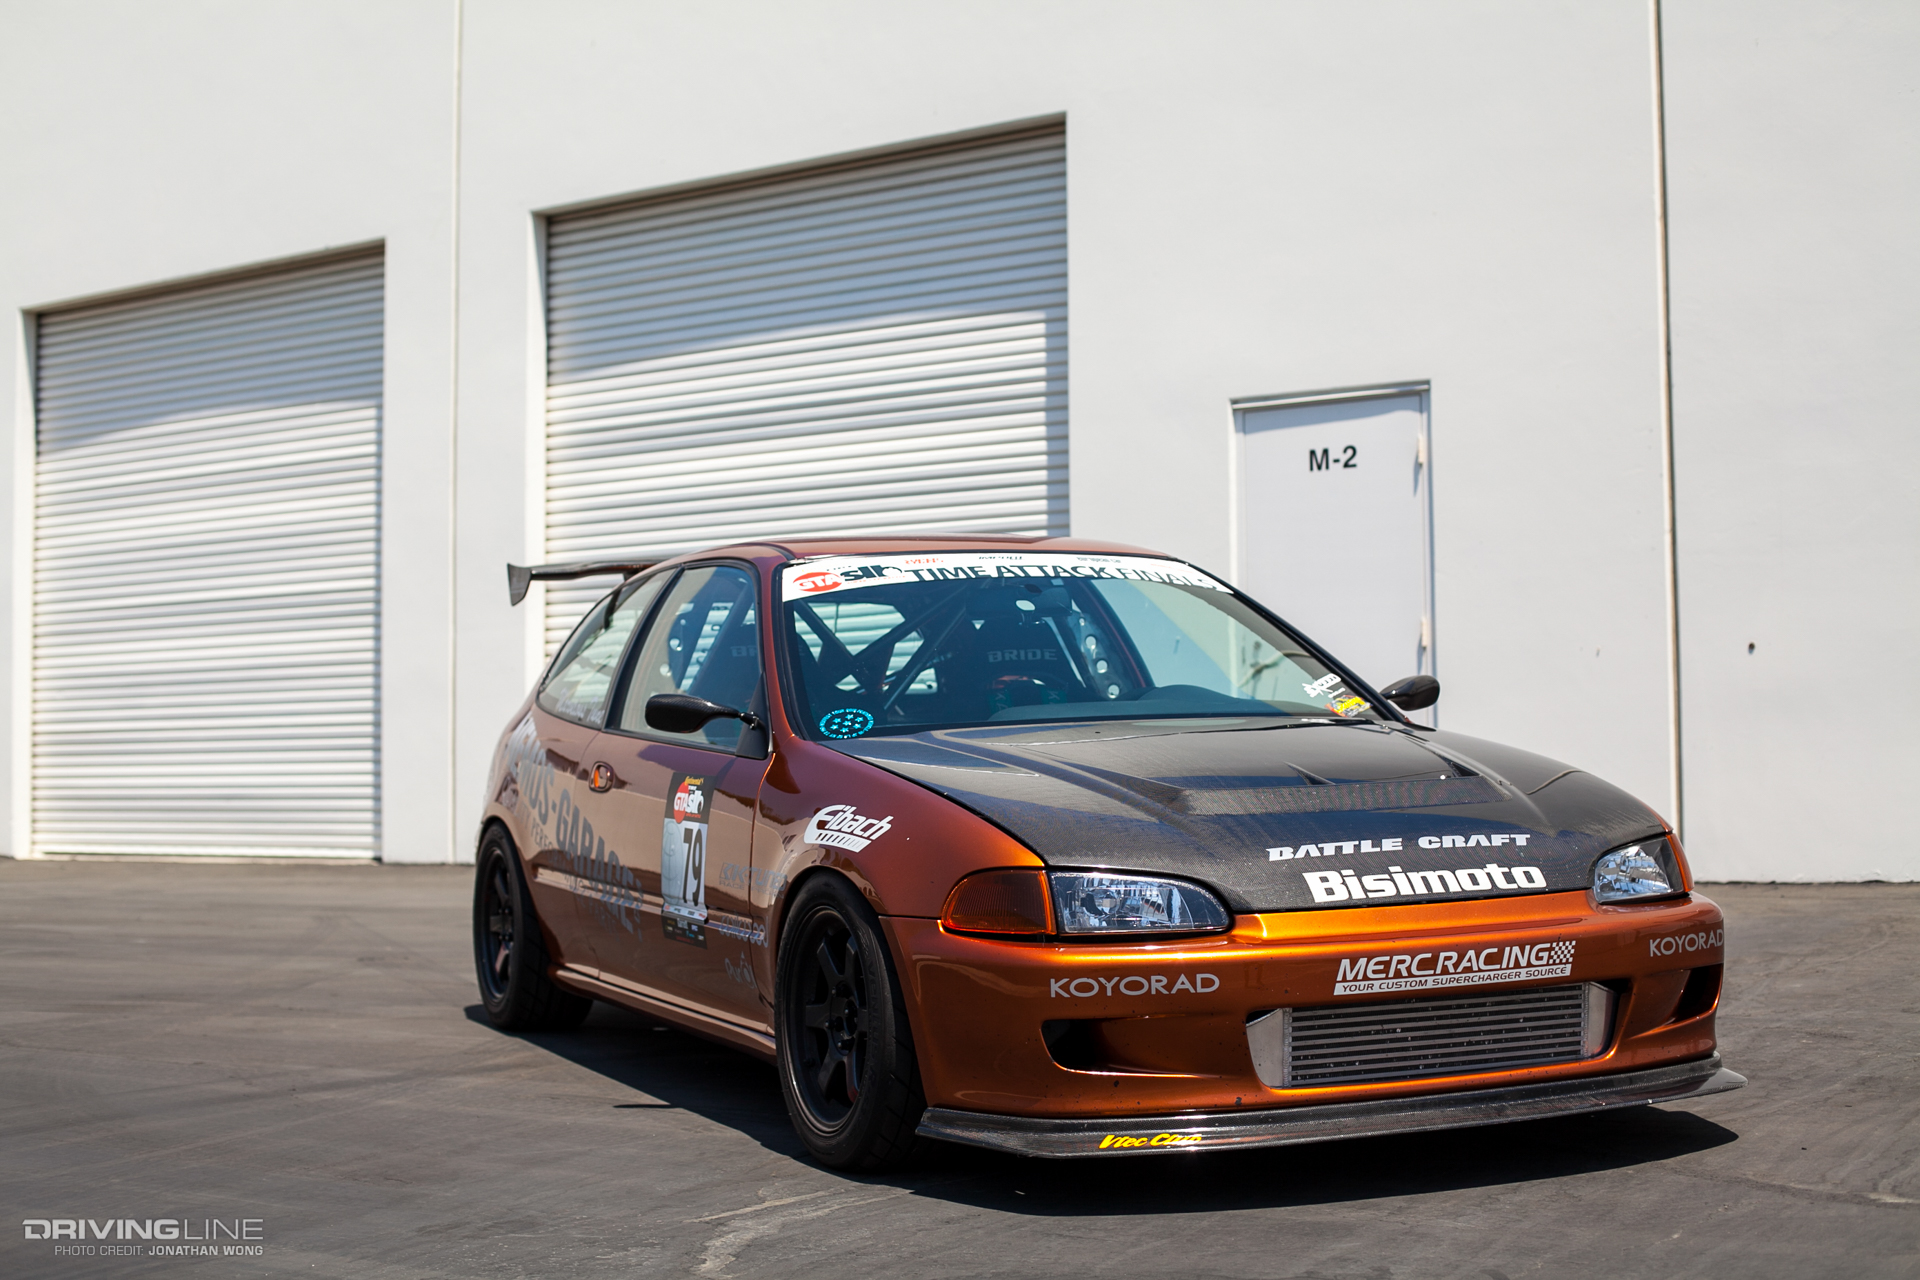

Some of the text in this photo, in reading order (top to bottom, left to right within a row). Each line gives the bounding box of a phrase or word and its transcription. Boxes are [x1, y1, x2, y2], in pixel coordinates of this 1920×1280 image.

[1309, 445, 1357, 472] M-2
[799, 573, 842, 588] GTA
[904, 565, 989, 582] TIME
[990, 565, 1120, 580] ATTACK
[986, 649, 1058, 663] BRIDE
[804, 804, 894, 853] Eibach
[1266, 833, 1531, 862] BATTLE CRAFT
[683, 827, 703, 907] 79
[1302, 863, 1548, 903] Bisimoto
[1649, 928, 1724, 957] KOYORAD
[1050, 973, 1220, 998] KOYORAD
[1342, 966, 1568, 993] YOUR CUSTOM SUPERCHARGER SOURCE
